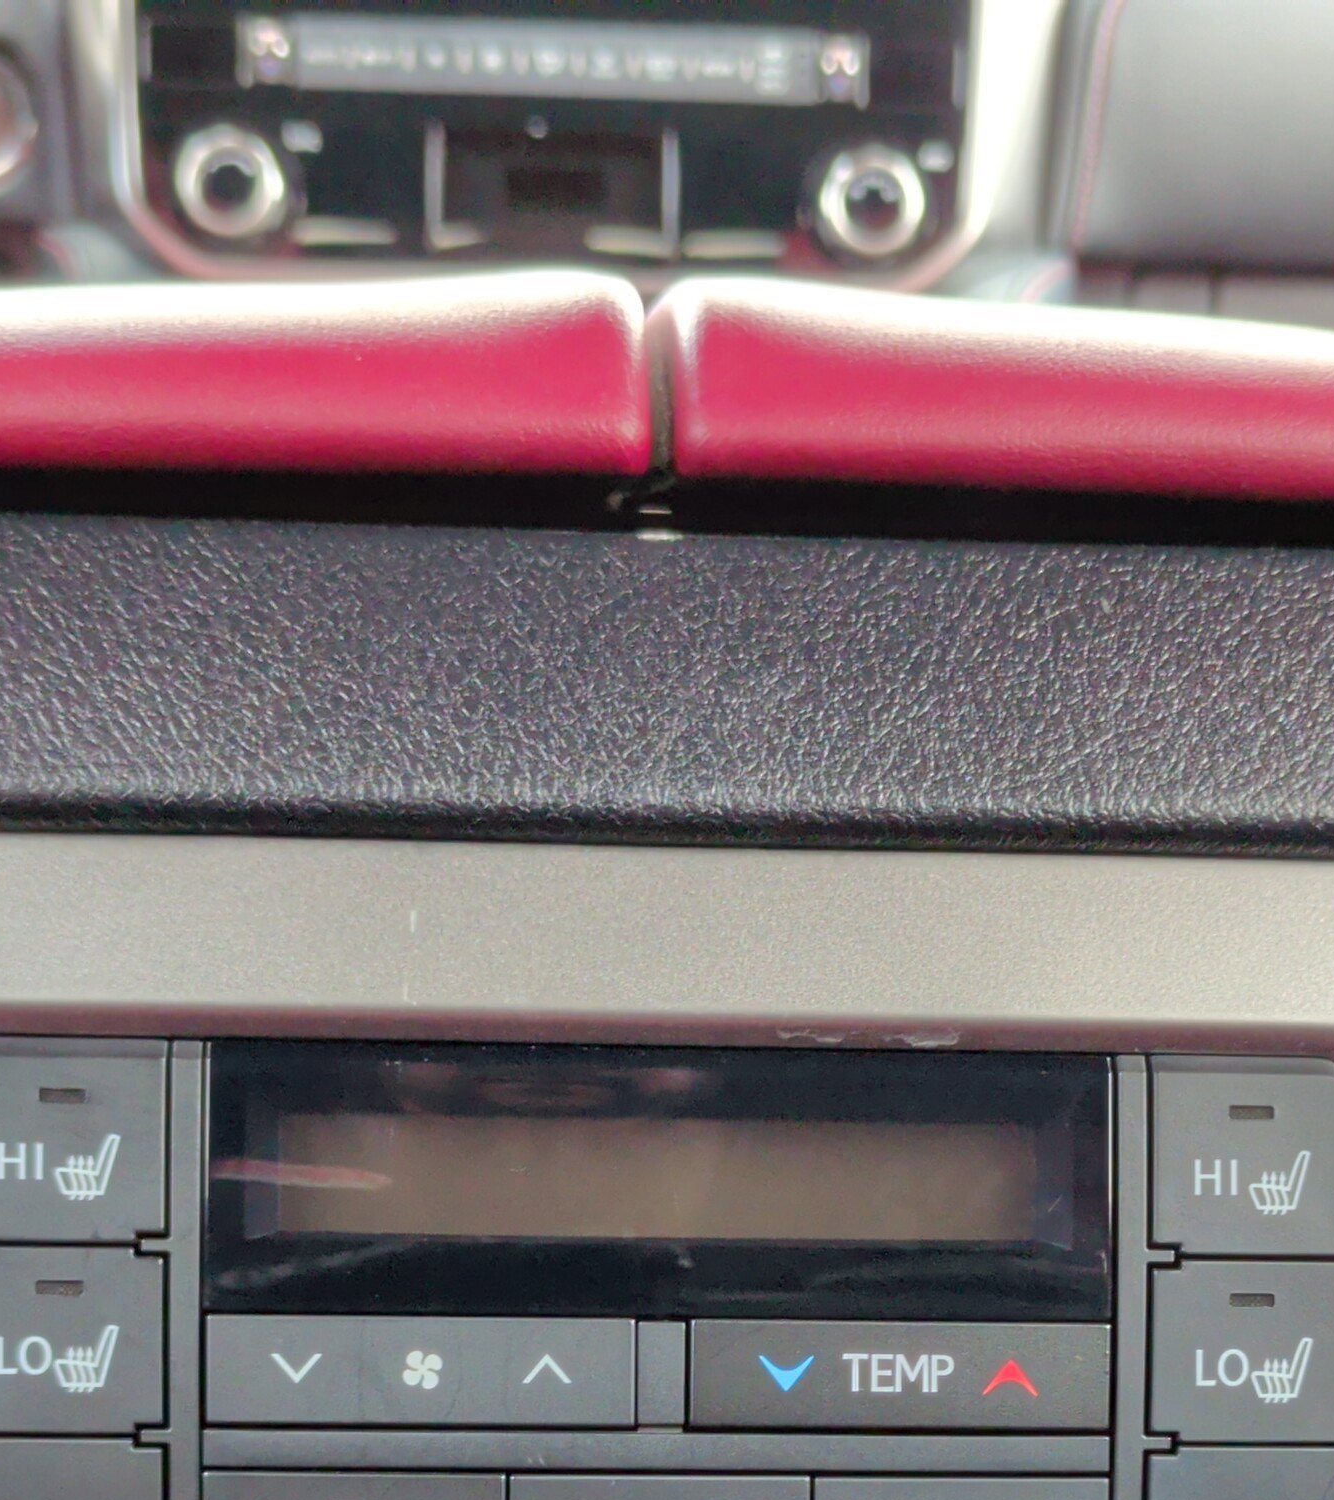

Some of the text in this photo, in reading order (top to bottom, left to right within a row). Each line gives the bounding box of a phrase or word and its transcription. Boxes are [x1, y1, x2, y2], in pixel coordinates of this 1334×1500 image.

[1192, 1159, 1240, 1196] HI
[842, 1353, 955, 1393] TEMP
[1195, 1349, 1249, 1388] LO
